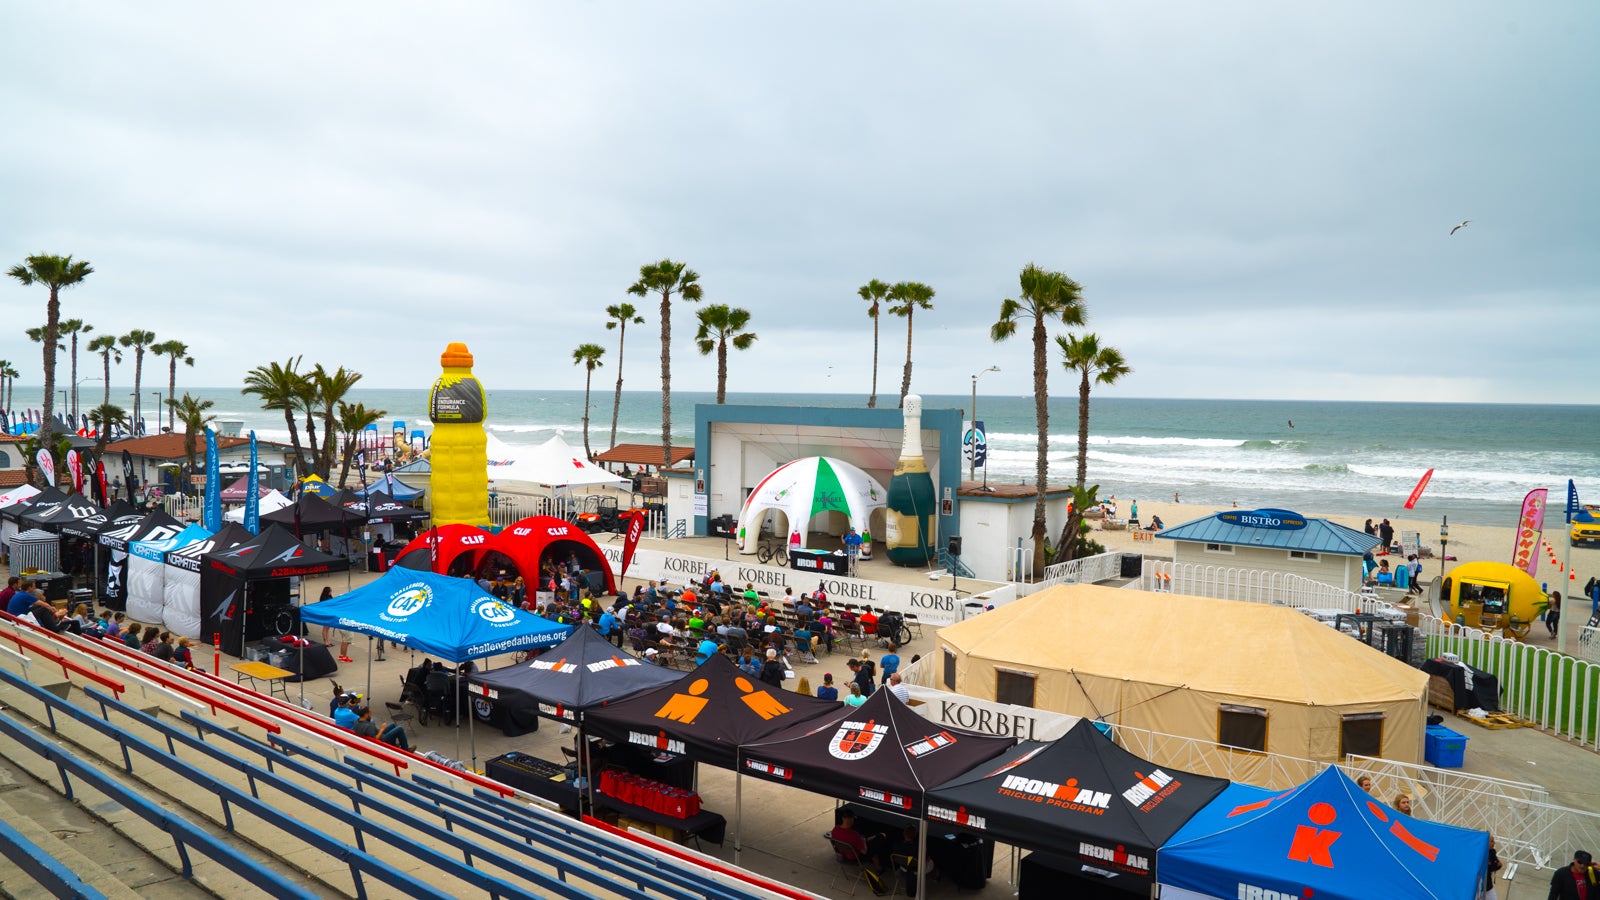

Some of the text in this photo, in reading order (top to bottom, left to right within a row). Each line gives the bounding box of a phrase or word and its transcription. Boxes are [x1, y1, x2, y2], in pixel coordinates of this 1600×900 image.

[1241, 516, 1280, 526] BISTRO
[460, 535, 485, 545] CLIF
[513, 526, 532, 536] CLIF
[547, 526, 568, 536] CLIF
[630, 520, 640, 542] CLIF
[1133, 531, 1154, 542] EXIT
[100, 536, 125, 550] NORMATEC
[168, 554, 200, 572] NORMATEC
[664, 557, 708, 575] KORBEL
[797, 556, 835, 570] IRONMAN
[738, 568, 788, 587] KORBEL
[392, 597, 418, 612] CAF
[482, 607, 508, 618] CAF
[468, 631, 567, 656] challengedathletes.org
[529, 658, 578, 674] IRONMAN
[586, 655, 642, 673] IRONMAN
[468, 682, 498, 700] IRONMAN
[538, 703, 575, 720] IRONMAN
[840, 720, 888, 734] IRONMAN
[940, 700, 1042, 742] KORBEL
[628, 731, 686, 755] IRONMAN
[854, 736, 880, 758] COACH
[1001, 774, 1112, 808] IRONMAN
[1122, 768, 1174, 808] IRONMAN
[1140, 780, 1182, 814] TRICLUB PROGRAM
[865, 790, 903, 806] IRONMAN
[998, 788, 1104, 816] TRICLUB PROGRAM
[928, 804, 986, 830] IRONMAN
[1080, 842, 1149, 870] IRONMAN
